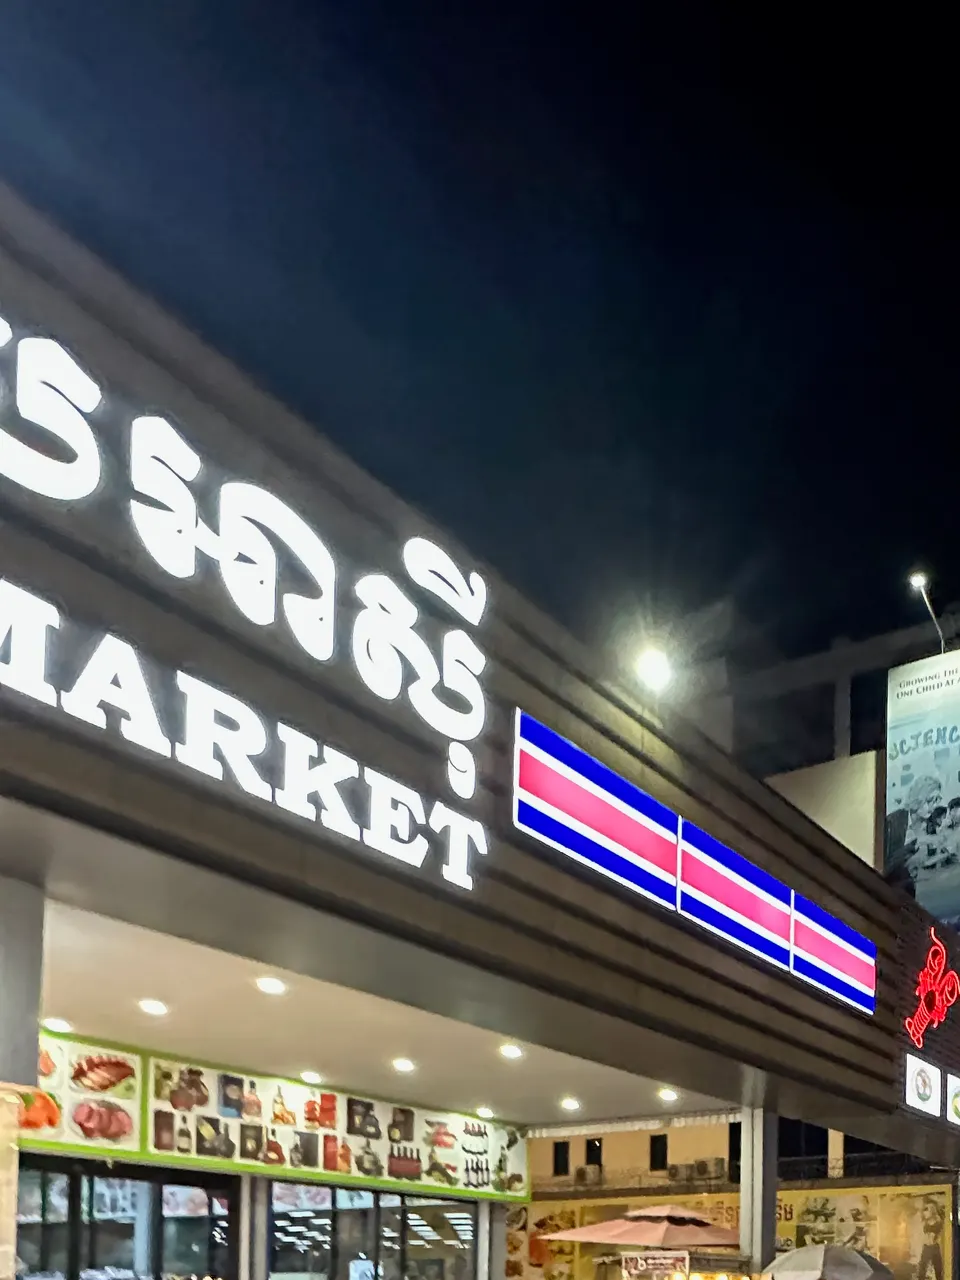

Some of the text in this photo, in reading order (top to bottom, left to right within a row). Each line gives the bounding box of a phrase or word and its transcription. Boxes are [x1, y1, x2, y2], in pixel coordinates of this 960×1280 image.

[899, 674, 940, 689] GROWING
[896, 687, 914, 700] ONE
[916, 682, 943, 695] CHILD
